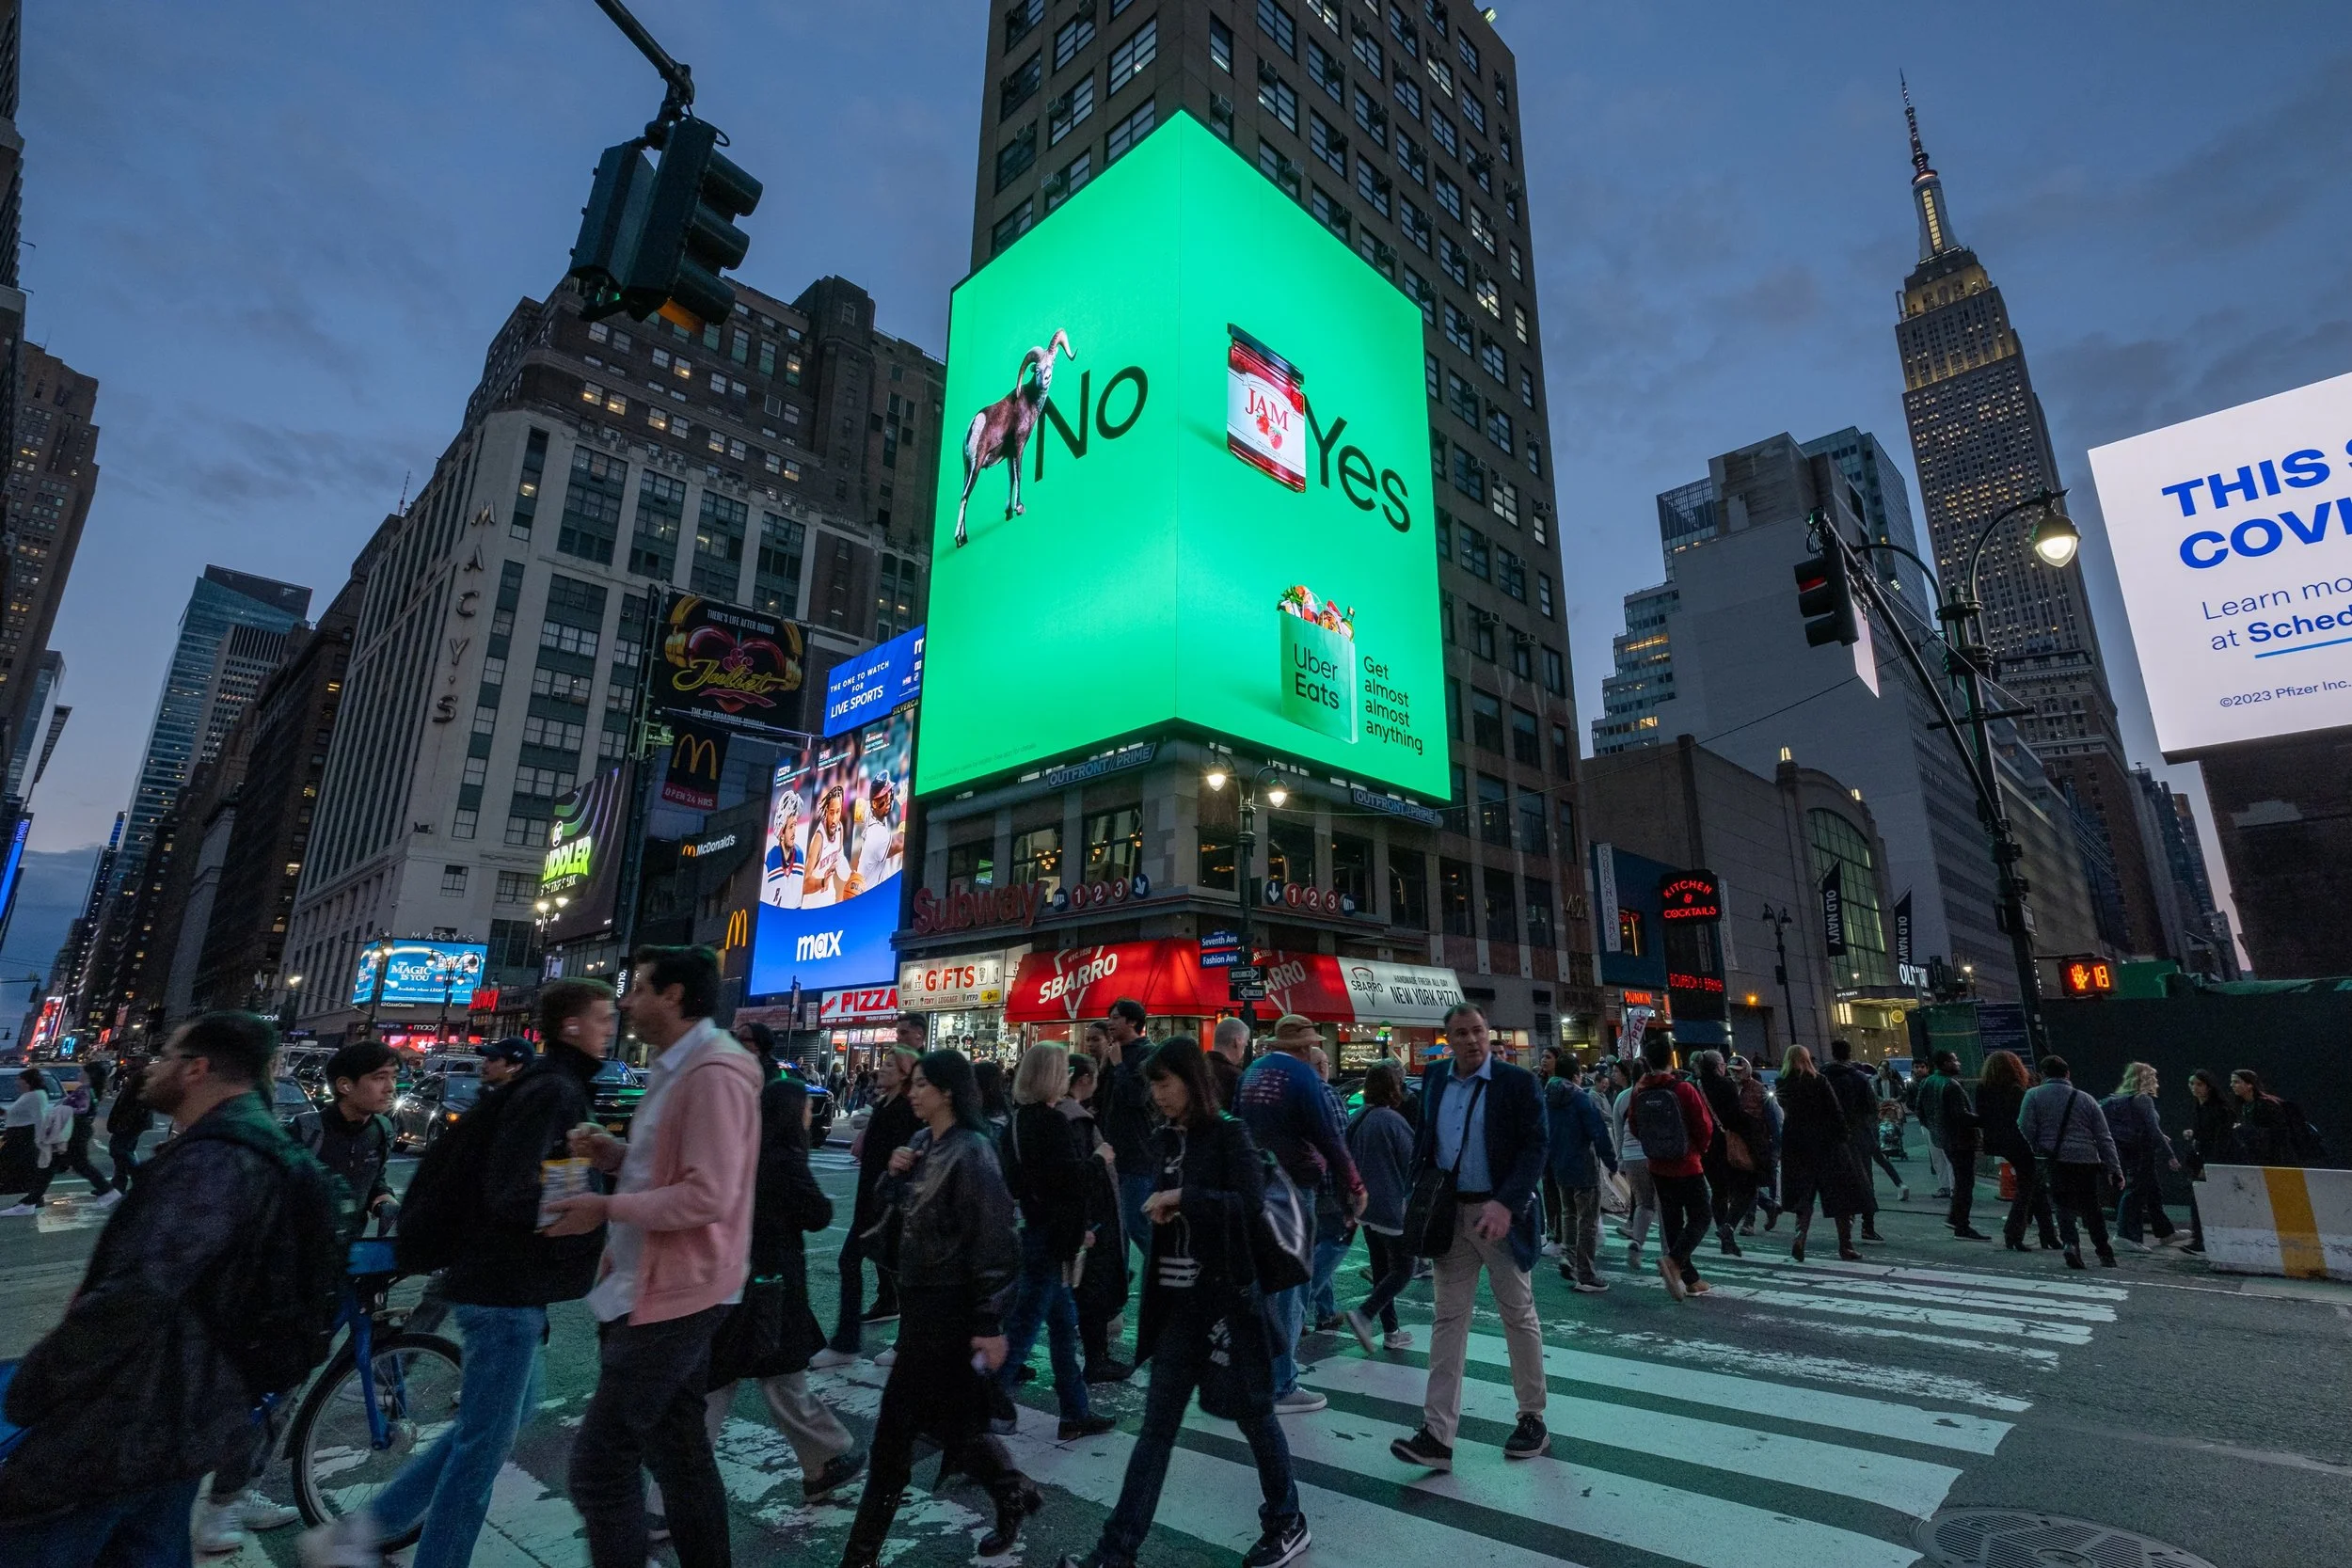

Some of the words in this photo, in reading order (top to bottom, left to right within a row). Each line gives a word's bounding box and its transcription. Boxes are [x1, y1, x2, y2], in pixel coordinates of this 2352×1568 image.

[1245, 388, 1289, 432] JAM
[1304, 394, 1412, 533] Yes
[2161, 449, 2330, 517] THIS
[2201, 589, 2291, 621] Learn
[707, 610, 728, 624] THERE'S
[729, 615, 740, 626] LIFE
[740, 617, 756, 630] AFTER
[2211, 627, 2241, 651] at
[1295, 643, 1338, 681] Uber
[1363, 656, 1389, 680] Get
[672, 658, 788, 695] Juliet
[830, 683, 841, 692] THE
[843, 676, 855, 688] ONE
[857, 672, 866, 680] TO
[866, 660, 890, 676] WATCH
[851, 682, 864, 692] FOR
[831, 700, 849, 718] LIVE
[850, 685, 883, 710] SPORTS
[1295, 672, 1340, 709] Eats
[1364, 678, 1409, 707] almost
[2219, 689, 2272, 708] ©2023
[2276, 684, 2319, 699] Pfizer
[2322, 680, 2352, 690] Inc.
[1365, 699, 1410, 727] almost
[1366, 720, 1423, 755] anything
[1115, 746, 1151, 768] PRIME
[665, 787, 686, 800] OPEN
[687, 793, 696, 804] 24
[697, 797, 713, 807] HRS
[1410, 806, 1436, 821] PRIME
[696, 834, 736, 857] McDonald's
[1094, 885, 1103, 901] 2
[1114, 881, 1123, 897] 3
[1310, 893, 1318, 907] 2
[1327, 895, 1336, 909] 3
[1663, 879, 1712, 899] KITCHEN
[1826, 890, 1836, 911] OLD
[914, 880, 1042, 934] Subway
[1663, 906, 1716, 919] COCKTAILS
[1827, 913, 1841, 945] NAVY
[1898, 916, 1908, 934] OLD
[796, 930, 844, 961] max
[1201, 936, 1225, 946] Seventh
[1226, 935, 1238, 943] Ave
[1898, 937, 1909, 964] NAVY
[390, 964, 432, 975] MAGIC
[1202, 956, 1225, 965] Fashion
[1225, 954, 1237, 962] Ave
[1038, 953, 1118, 1005] SBARRO
[1263, 960, 1307, 994] ARRO
[1351, 980, 1384, 993] SBARRO
[1393, 974, 1418, 985] HANDMADE
[1418, 976, 1432, 986] FRESH
[1432, 978, 1440, 987] ALL
[840, 988, 898, 1013] PIZZA
[1391, 986, 1414, 1005] NEW
[1413, 989, 1438, 1006] YORK
[1438, 990, 1461, 1007] PIZZA
[1625, 991, 1652, 1006] DUNKIN'
